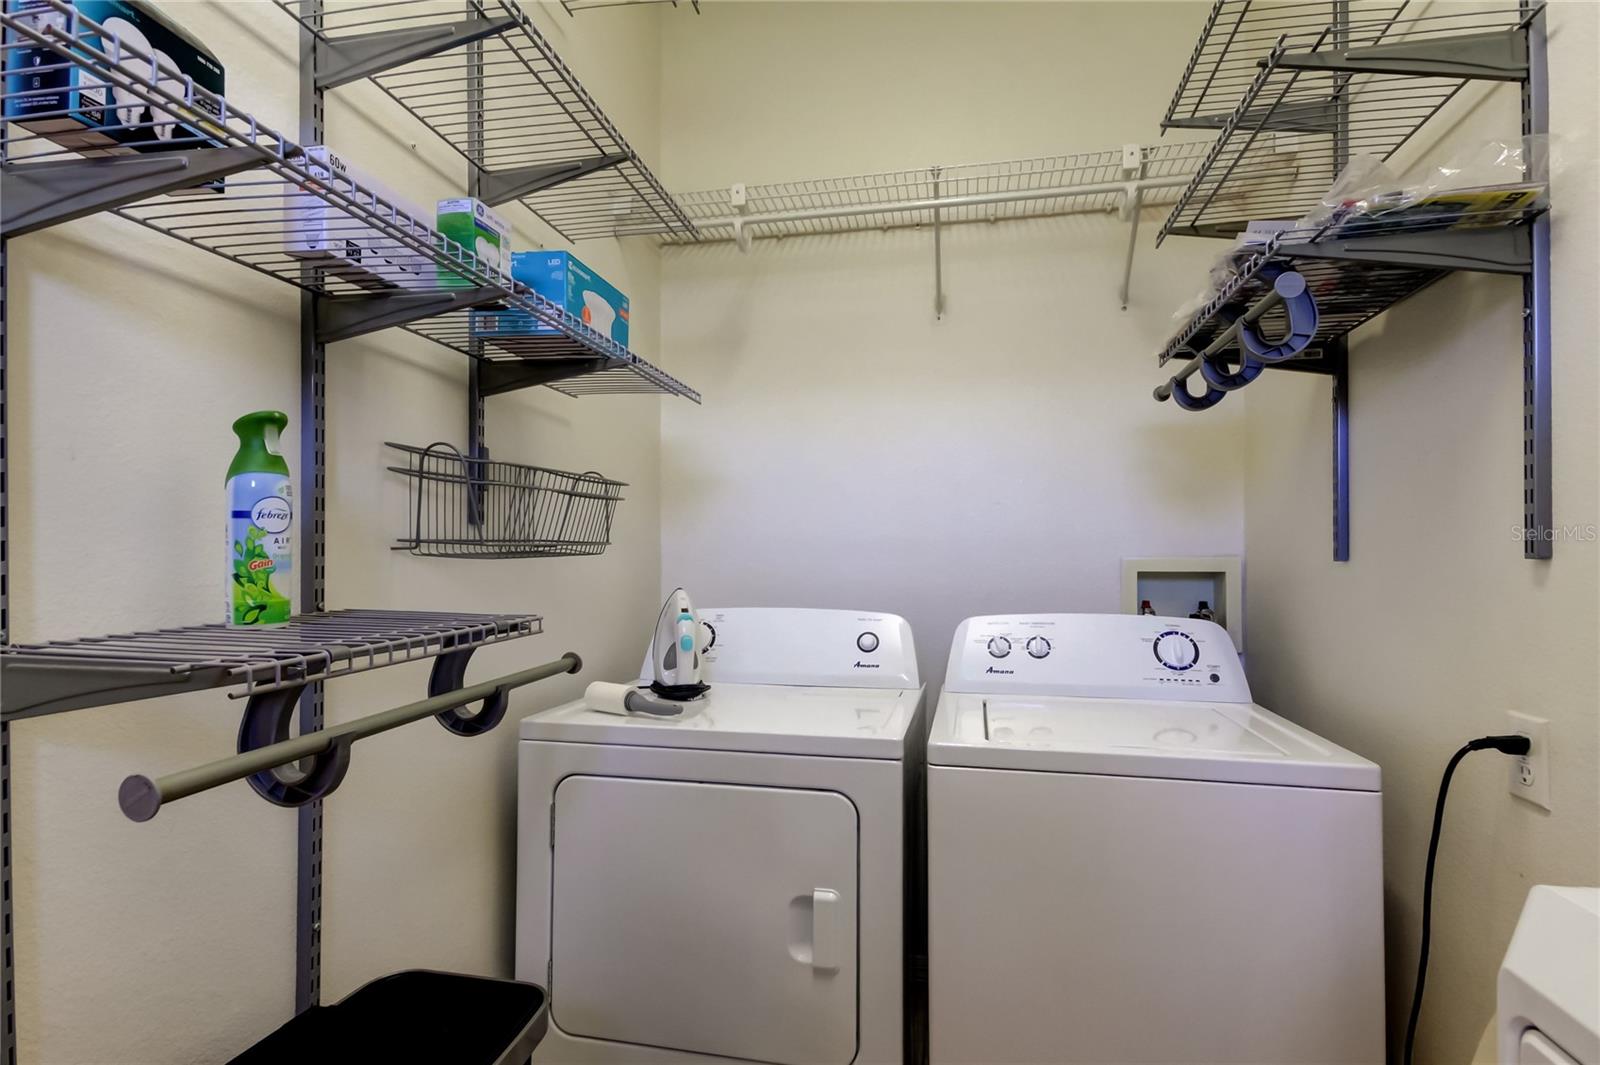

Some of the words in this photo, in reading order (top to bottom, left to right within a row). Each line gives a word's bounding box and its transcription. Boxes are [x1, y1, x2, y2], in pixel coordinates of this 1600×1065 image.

[249, 559, 274, 571] Gain
[853, 661, 880, 669] Amana
[985, 666, 1015, 675] Amana
